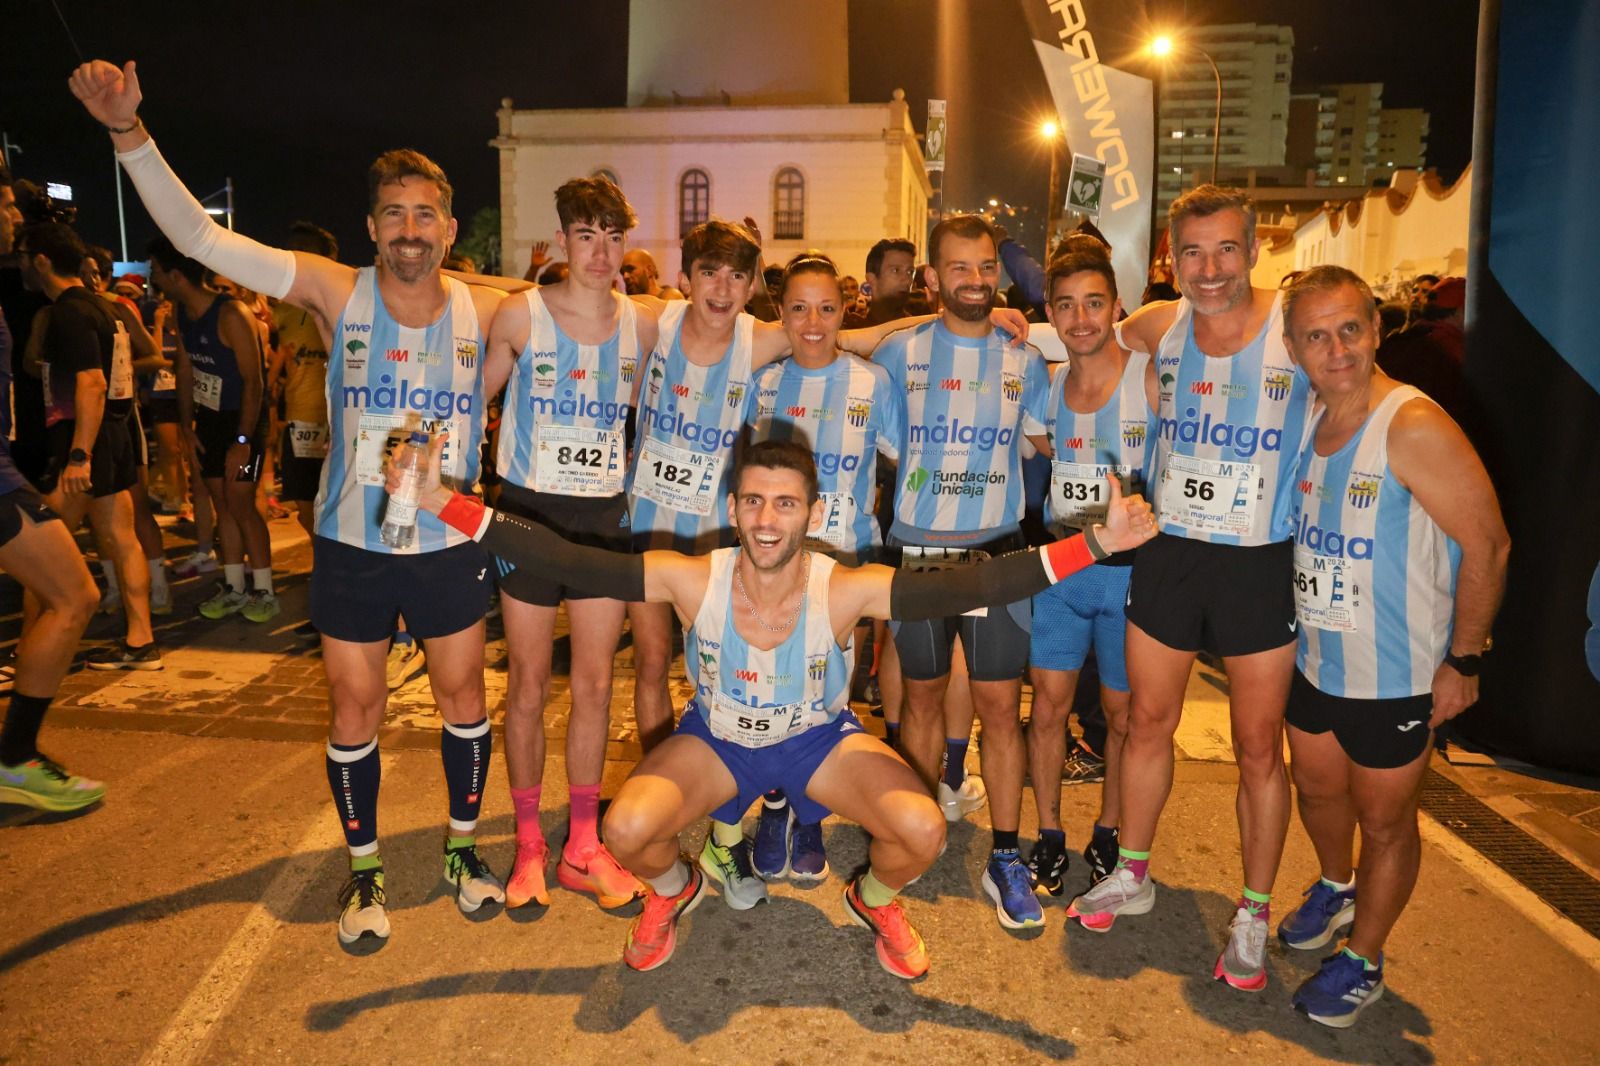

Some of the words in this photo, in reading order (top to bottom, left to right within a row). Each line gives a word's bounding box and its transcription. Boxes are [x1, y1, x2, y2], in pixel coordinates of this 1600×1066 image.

[344, 323, 371, 333] vive
[906, 363, 930, 371] vive
[296, 431, 320, 442] 307
[597, 431, 607, 443] M
[558, 446, 602, 467] 842
[690, 454, 702, 465] M
[653, 461, 693, 486] 182
[1219, 463, 1232, 476] M
[933, 469, 1006, 485] Fundación
[931, 483, 985, 499] Unicaja
[1063, 482, 1101, 502] 831
[1183, 478, 1215, 501] 56
[1190, 511, 1225, 522] mayoral
[1313, 558, 1326, 571] M
[773, 707, 787, 716] M
[737, 716, 770, 731] 55
